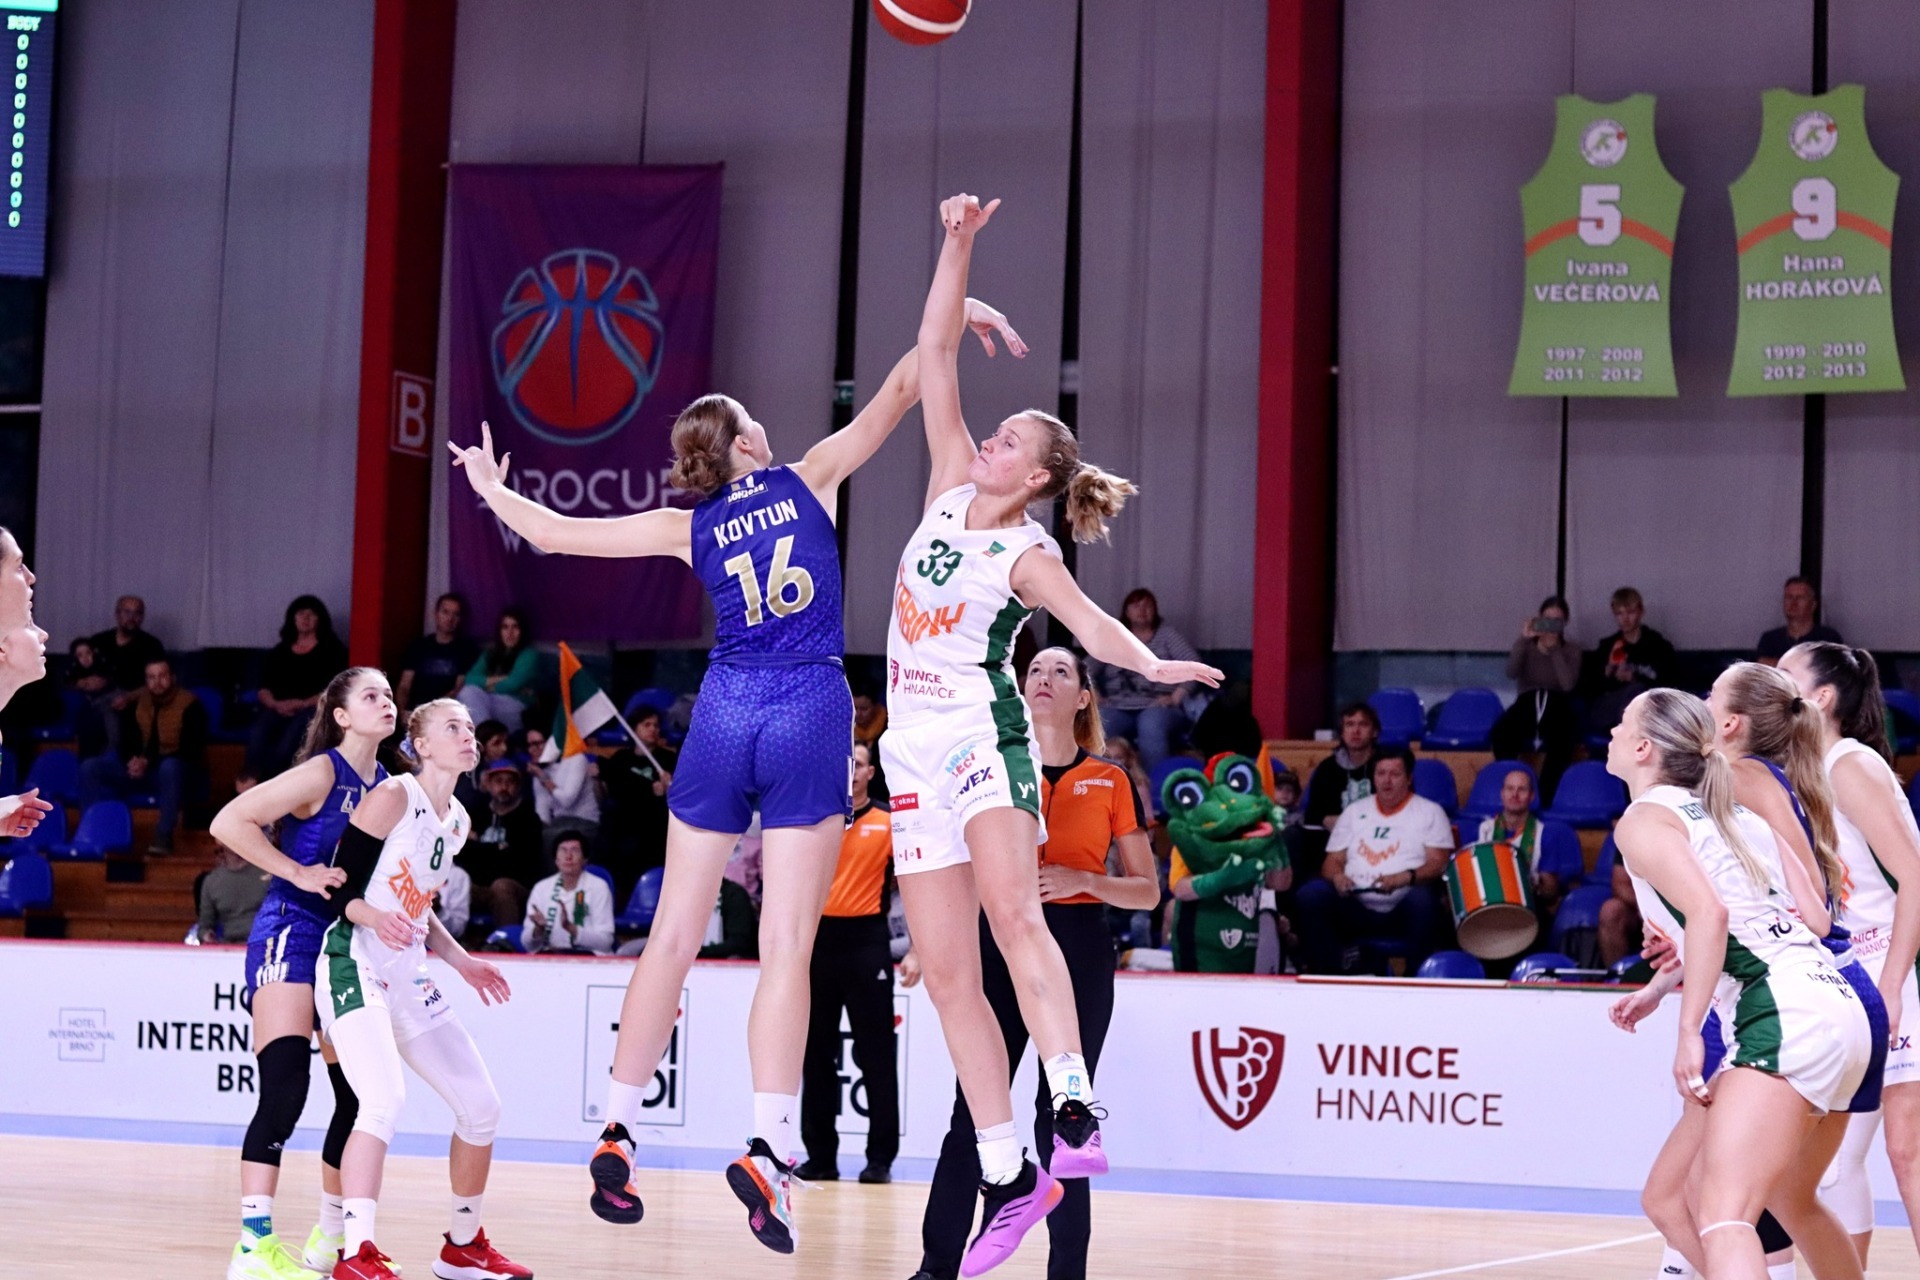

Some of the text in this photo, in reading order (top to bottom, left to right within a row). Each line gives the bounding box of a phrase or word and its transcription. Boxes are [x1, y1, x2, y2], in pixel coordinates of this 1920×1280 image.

[17, 34, 29, 50] 0
[16, 53, 28, 70] 0
[15, 73, 27, 90] 0
[14, 93, 26, 109] 0
[13, 112, 25, 129] 0
[12, 132, 24, 149] 0
[11, 151, 23, 168] 0
[10, 171, 22, 188] 0
[10, 191, 22, 208] 0
[1578, 184, 1622, 246] 5
[1791, 177, 1837, 241] 9
[8, 210, 20, 228] 0
[1567, 259, 1629, 277] Ivana
[1783, 255, 1845, 273] Hana
[1746, 274, 1883, 300] HORÁKOVÁ
[1547, 348, 1585, 361] 1997
[1764, 342, 1866, 360] 1999 2010
[1544, 367, 1643, 381] 2011 2012
[1763, 362, 1866, 381] 2012 2013
[400, 381, 427, 448] B
[713, 499, 799, 549] KOVTUN
[917, 539, 963, 587] 33
[724, 534, 814, 627] 16
[430, 837, 444, 871] 8
[1317, 1043, 1459, 1080] VINICE
[1316, 1087, 1503, 1127] HNANICE
